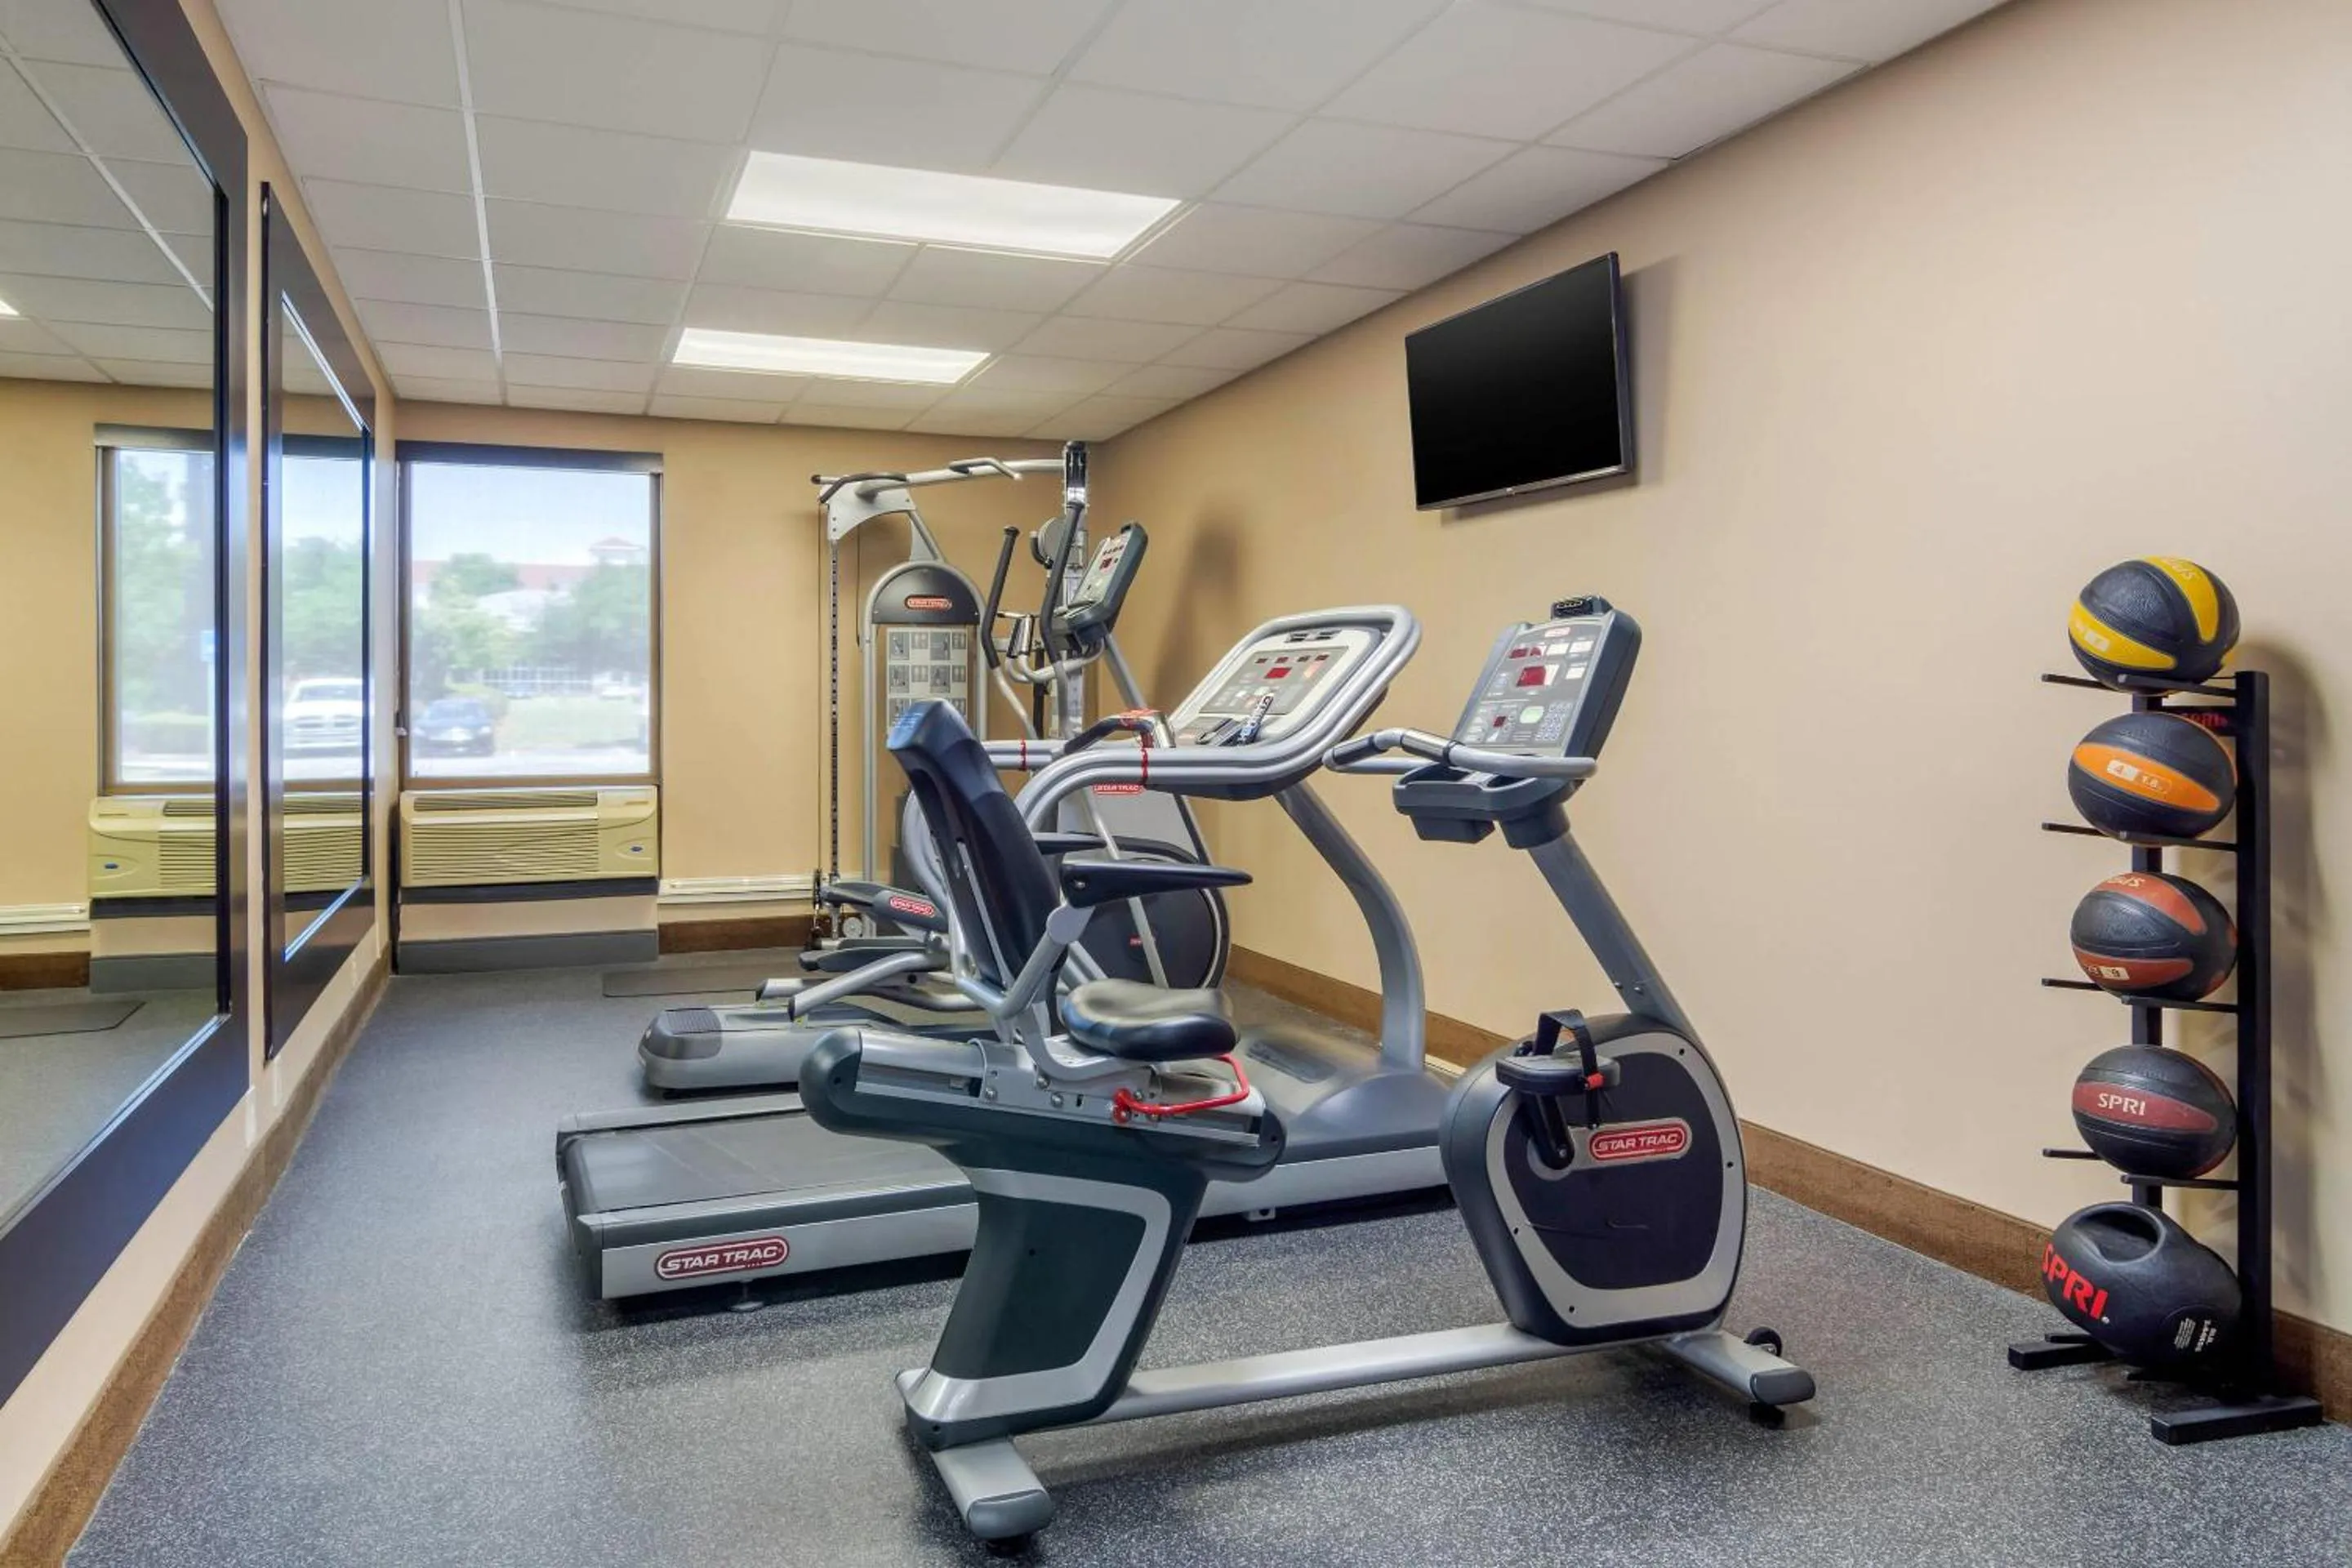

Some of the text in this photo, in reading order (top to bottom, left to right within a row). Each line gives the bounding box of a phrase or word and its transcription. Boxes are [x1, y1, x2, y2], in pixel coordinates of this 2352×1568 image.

[2097, 1093, 2146, 1116] SPRI
[1598, 1134, 1677, 1152] STAR TRAC
[666, 1246, 778, 1272] STAR TRAC
[2042, 1243, 2109, 1320] SPRI
